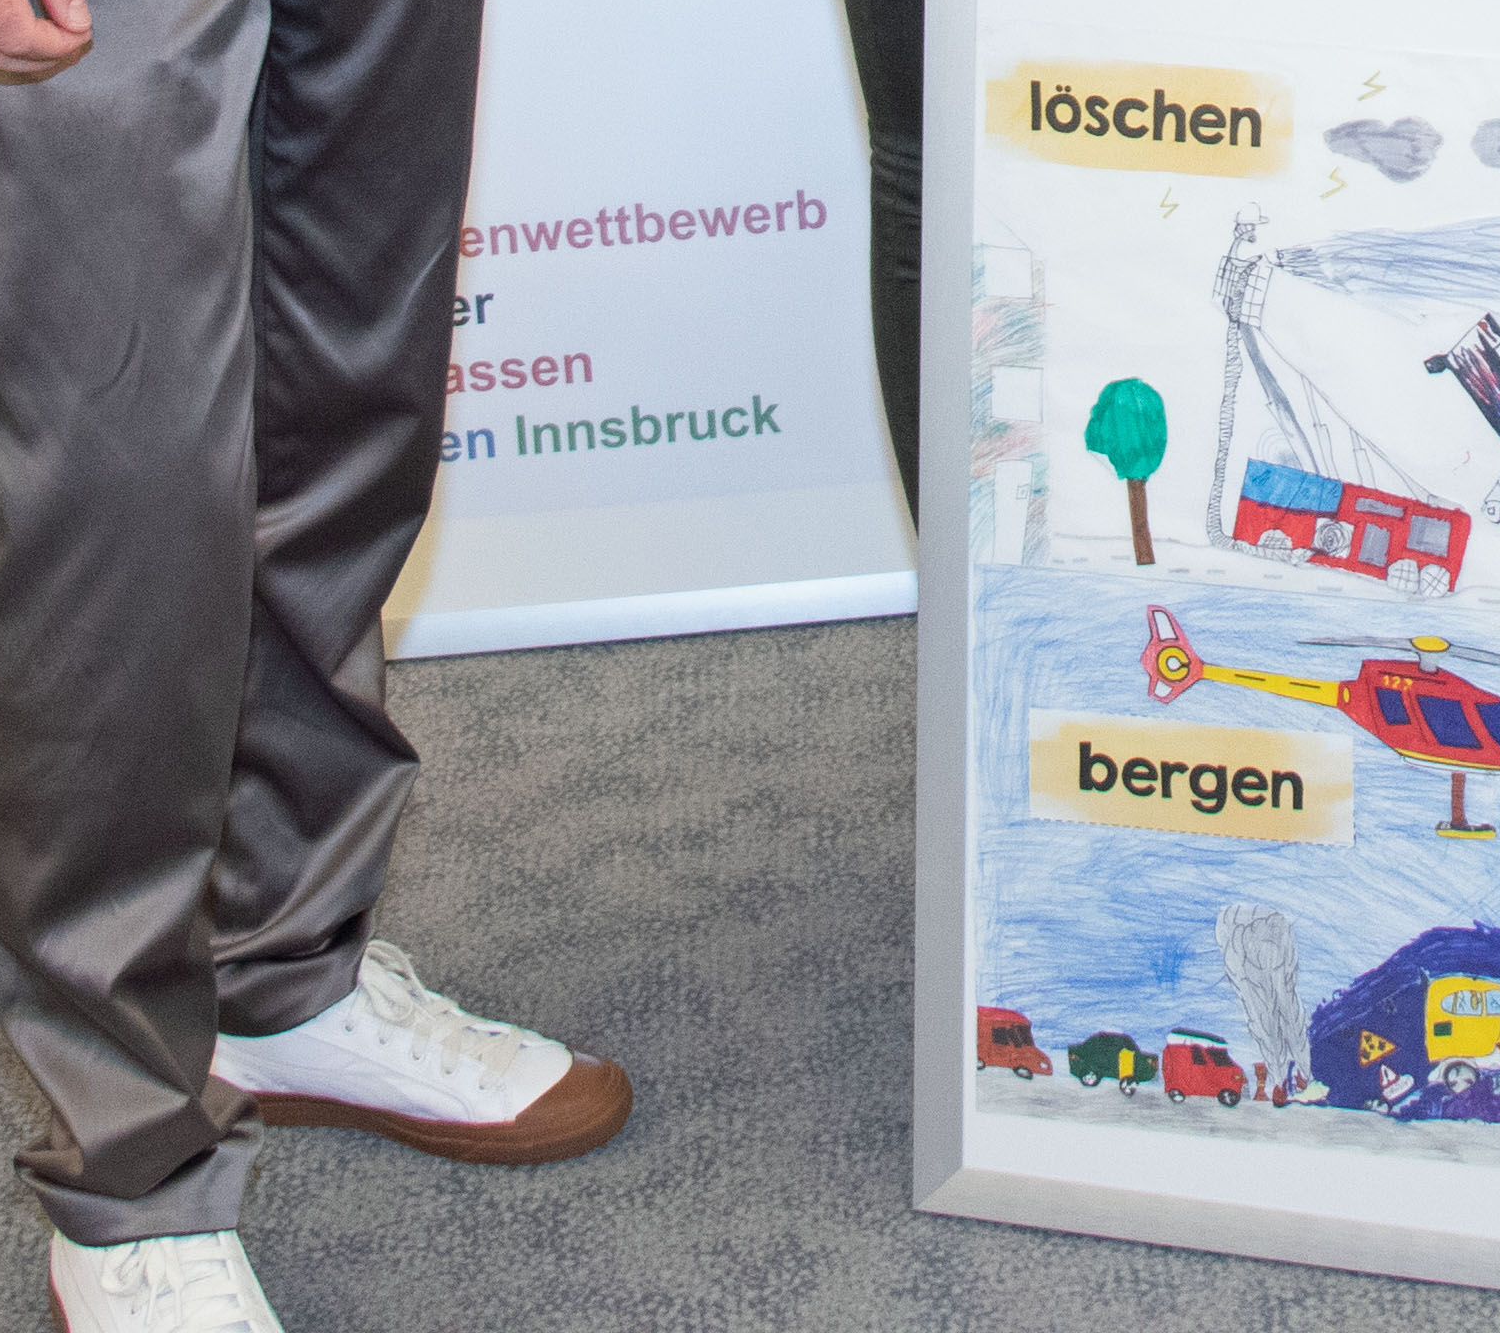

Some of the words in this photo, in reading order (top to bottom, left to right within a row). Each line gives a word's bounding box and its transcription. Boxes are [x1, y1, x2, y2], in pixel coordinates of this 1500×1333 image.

[1030, 81, 1262, 147] löschen
[459, 189, 827, 257] enwettbewerb
[516, 395, 782, 456] Innsbruck
[1079, 742, 1303, 813] bergen
